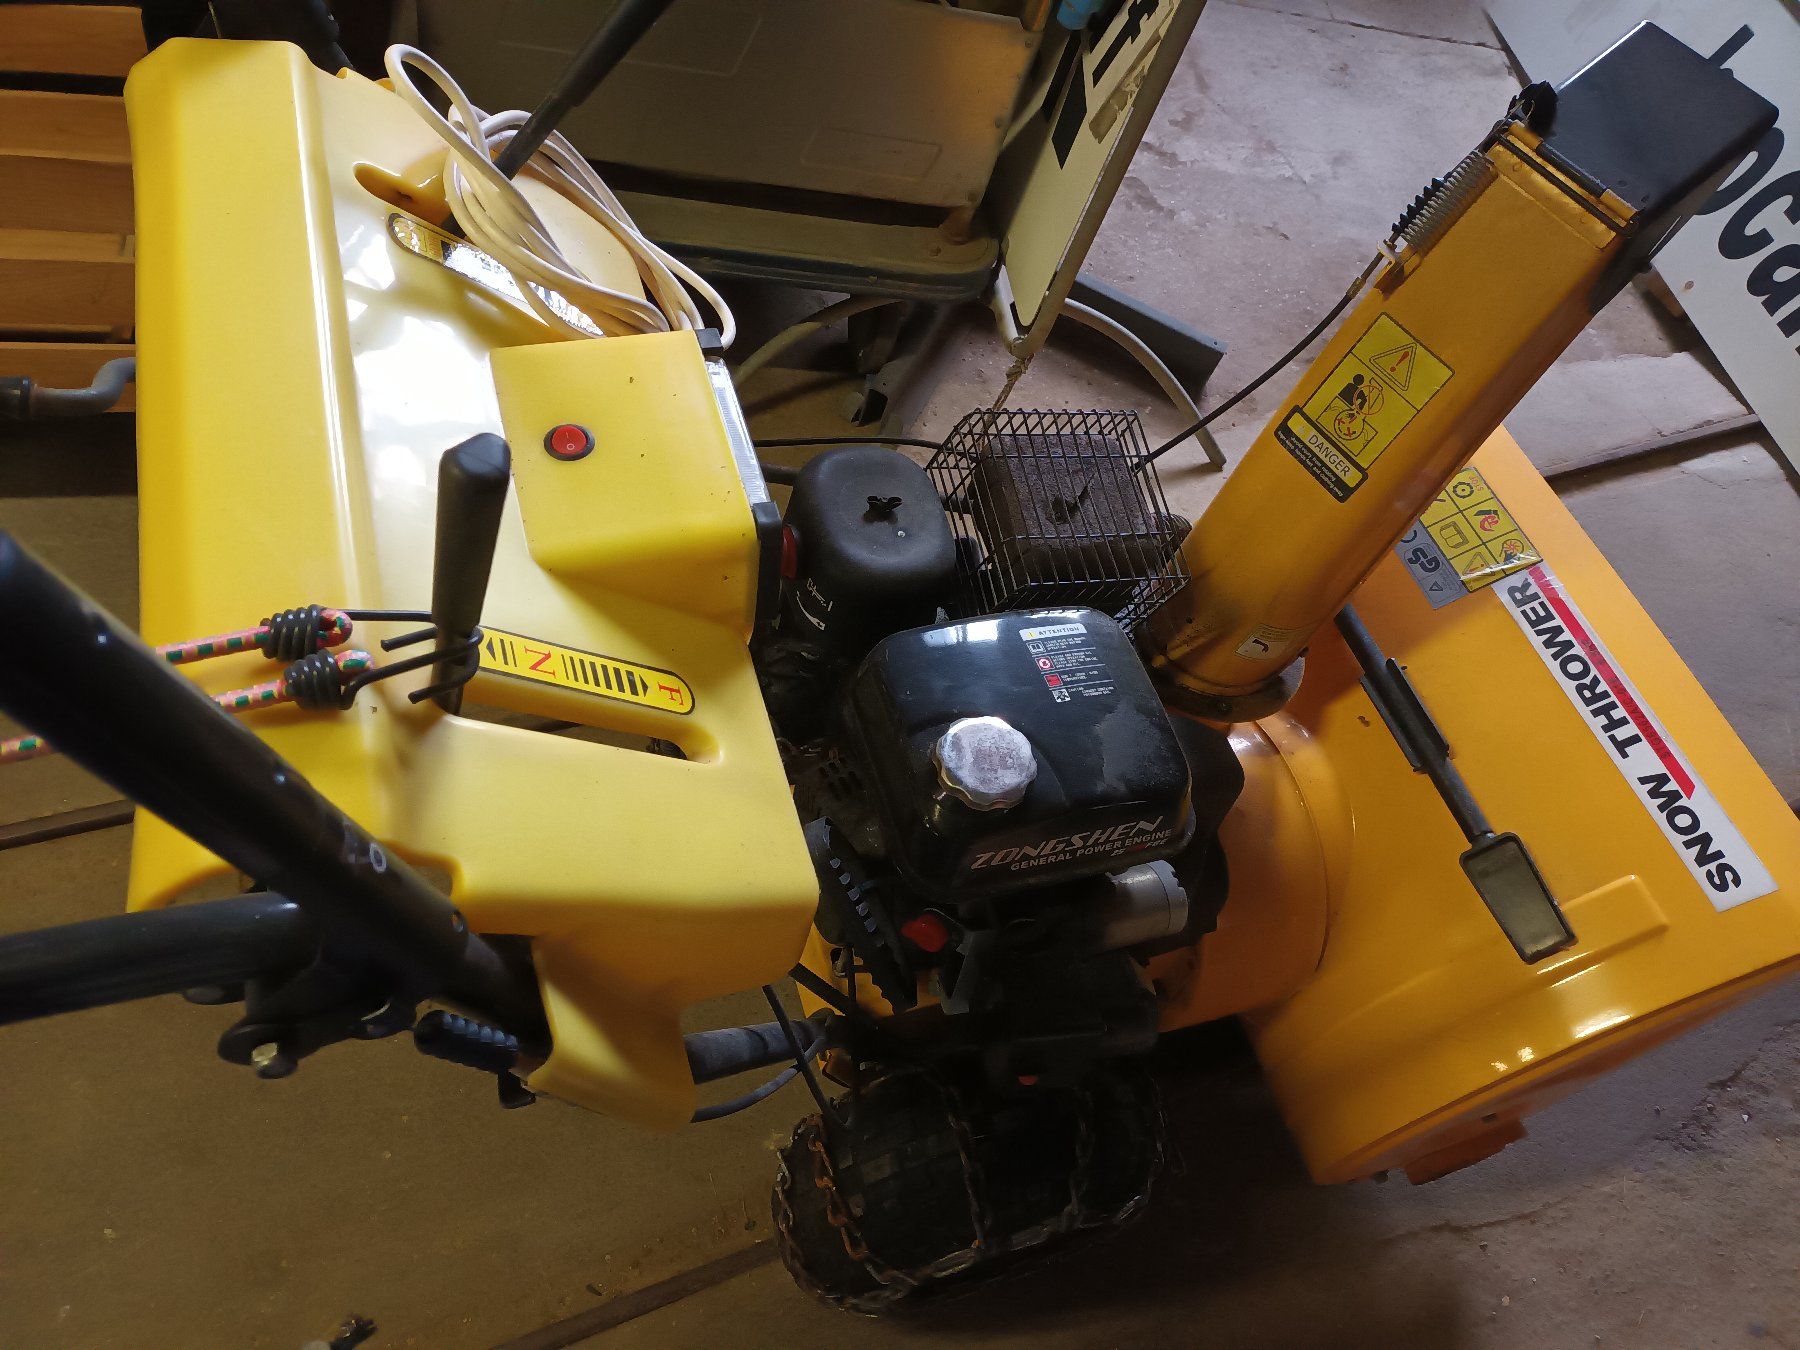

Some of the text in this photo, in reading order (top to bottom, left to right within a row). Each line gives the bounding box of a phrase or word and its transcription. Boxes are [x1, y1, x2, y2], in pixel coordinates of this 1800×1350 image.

[1308, 434, 1351, 477] DANGER
[1468, 476, 1484, 492] STOP
[1406, 547, 1441, 573] GS
[1038, 626, 1080, 636] ATTENTION
[524, 645, 557, 679] N
[1507, 577, 1642, 760] THROWER
[657, 681, 684, 706] F
[970, 815, 1164, 870] ZONGSHEN
[1010, 853, 1073, 871] GENERAL
[1076, 841, 1123, 857] POWER
[1125, 829, 1173, 847] ENGINE
[1637, 772, 1742, 893] SNOW
